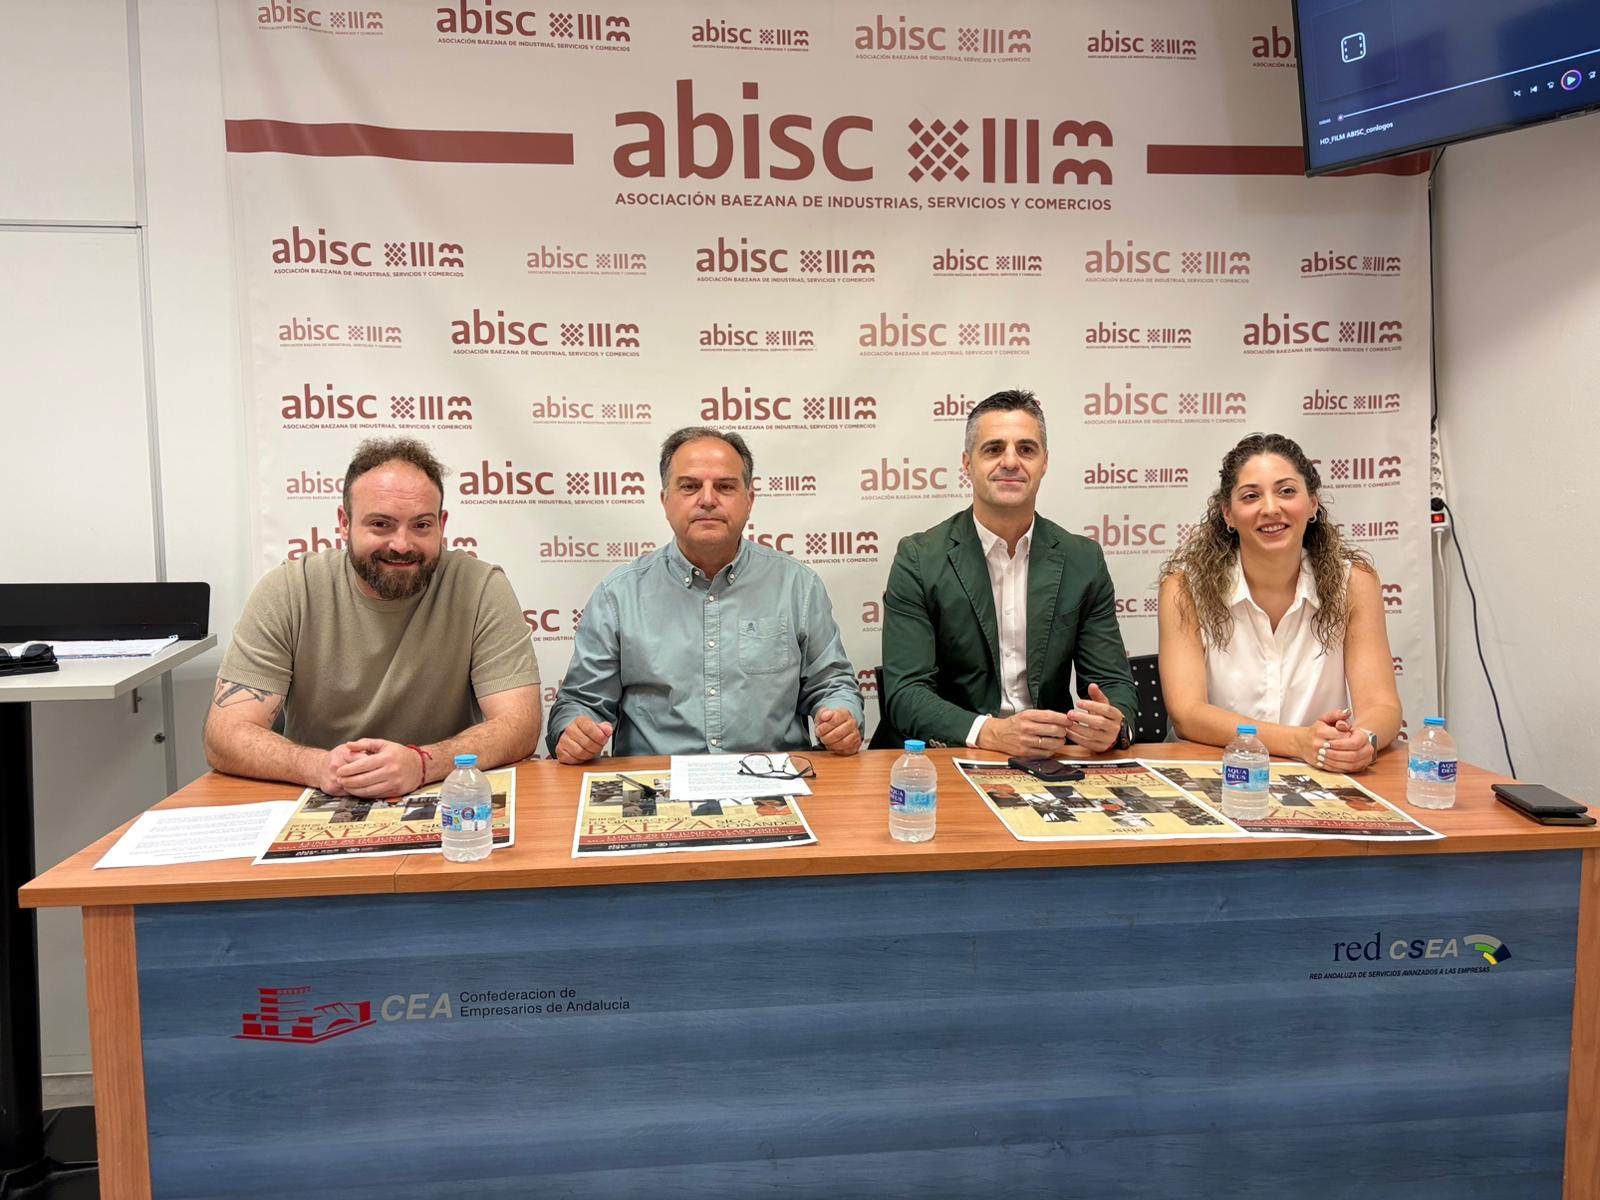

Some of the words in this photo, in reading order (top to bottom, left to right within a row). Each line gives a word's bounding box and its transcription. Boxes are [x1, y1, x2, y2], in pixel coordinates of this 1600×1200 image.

[258, 0, 322, 27] abisc
[437, 0, 536, 36] abisc
[438, 37, 476, 45] ASOCIACIÓN
[557, 42, 588, 50] SERVICIOS
[692, 19, 752, 44] abisc
[855, 15, 946, 51] abisc
[1088, 30, 1144, 52] abisc
[613, 79, 874, 183] abisc
[615, 191, 717, 206] ASOCIACIÓN
[721, 194, 798, 207] BAEZANA
[802, 196, 823, 207] DE
[828, 196, 923, 211] INDUSTRIAS,
[927, 196, 1006, 209] SERVICIOS
[1010, 198, 1020, 208] Y
[1025, 198, 1112, 211] COMERCIOS
[272, 226, 372, 267] abisc
[527, 245, 588, 268] abisc
[696, 237, 788, 273] abisc
[1085, 240, 1170, 273] abisc
[933, 248, 988, 270] abisc
[1301, 251, 1357, 272] abisc
[274, 267, 309, 275] ASOCIACIÓN
[311, 268, 342, 276] BAEZANA
[279, 317, 339, 340] abisc
[452, 309, 548, 346] abisc
[700, 323, 758, 346] abisc
[859, 313, 947, 347] abisc
[1086, 322, 1140, 343] abisc
[1243, 313, 1329, 345] abisc
[282, 384, 377, 419] abisc
[533, 396, 594, 418] abisc
[701, 387, 791, 421] abisc
[933, 394, 975, 416] abis
[1084, 383, 1168, 416] abisc
[1303, 389, 1348, 410] abisc
[460, 460, 554, 495] abisc
[861, 458, 947, 491] abisc
[1084, 463, 1138, 484] abisc
[540, 536, 599, 557] abisc
[1332, 932, 1382, 962] red
[1389, 938, 1459, 961] CSEA
[1368, 970, 1401, 978] SERVICIOS
[1457, 966, 1491, 975] EMPRESAS
[380, 992, 454, 1021] CEA
[459, 988, 556, 1004] Confederacion
[559, 987, 577, 999] de
[459, 1003, 542, 1019] Empresarios
[546, 1001, 563, 1014] de
